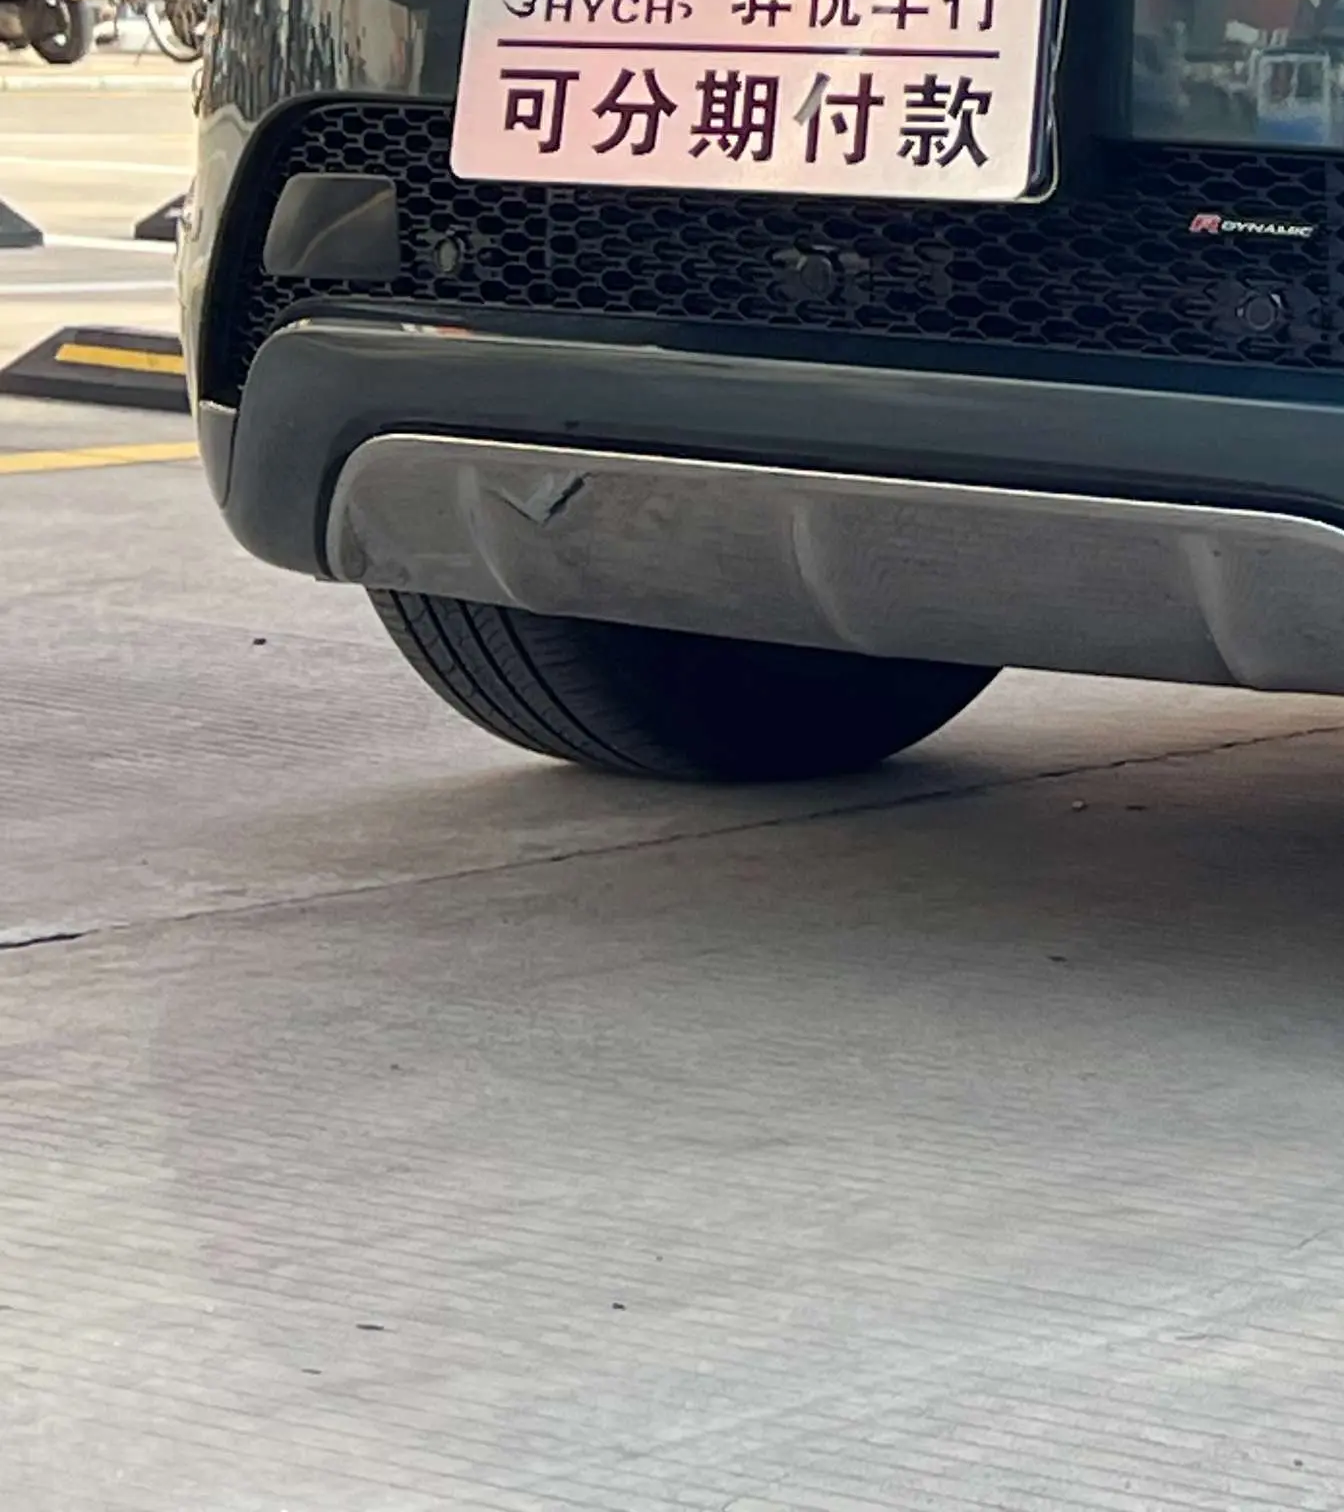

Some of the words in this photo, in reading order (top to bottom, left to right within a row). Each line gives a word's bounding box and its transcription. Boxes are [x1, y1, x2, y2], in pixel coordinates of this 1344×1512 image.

[499, 67, 993, 169] 可分期付款
